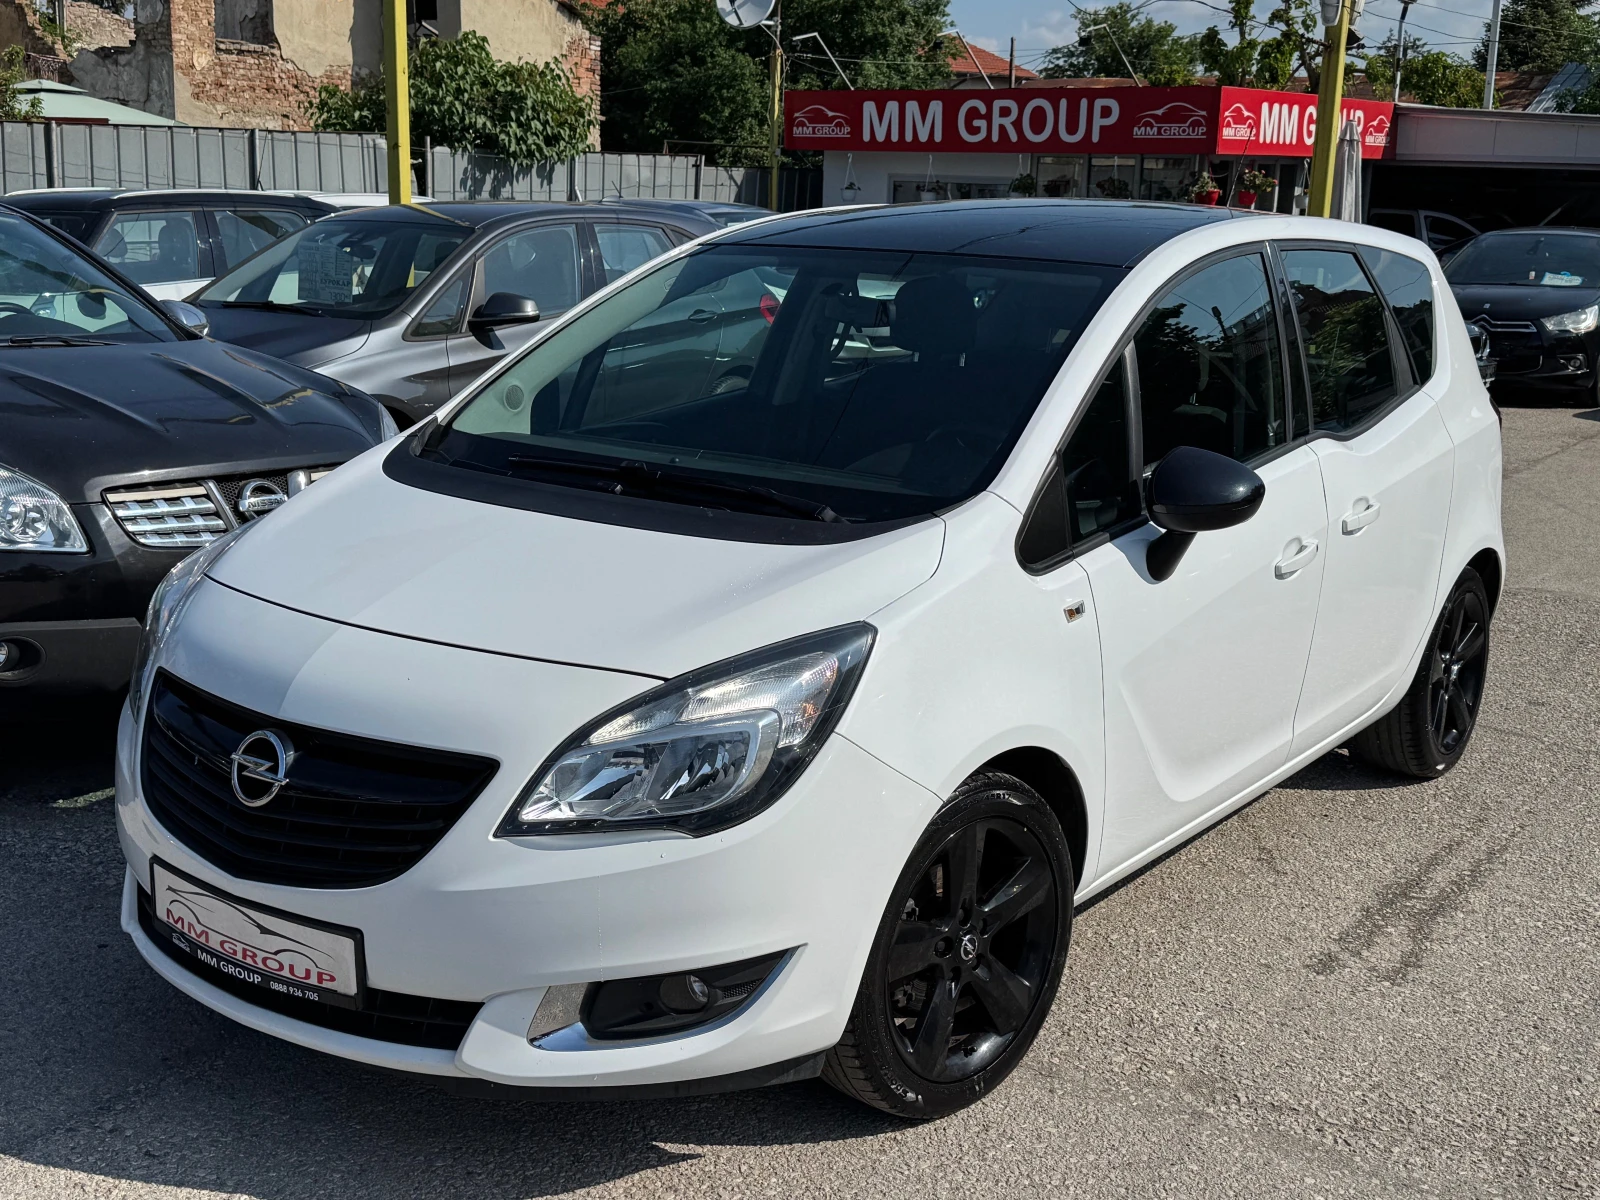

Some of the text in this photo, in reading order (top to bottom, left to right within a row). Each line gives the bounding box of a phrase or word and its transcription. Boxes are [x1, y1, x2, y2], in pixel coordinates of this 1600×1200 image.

[793, 127, 851, 136] MM GROUP
[863, 98, 1120, 144] MM GROUP
[1133, 126, 1207, 136] MM GROUP
[1222, 127, 1257, 138] MM GROUP
[1259, 102, 1300, 145] MM
[166, 907, 337, 985] MM GROUP
[197, 949, 262, 985] MM GROUP
[269, 981, 319, 1001] 0888 936 705
